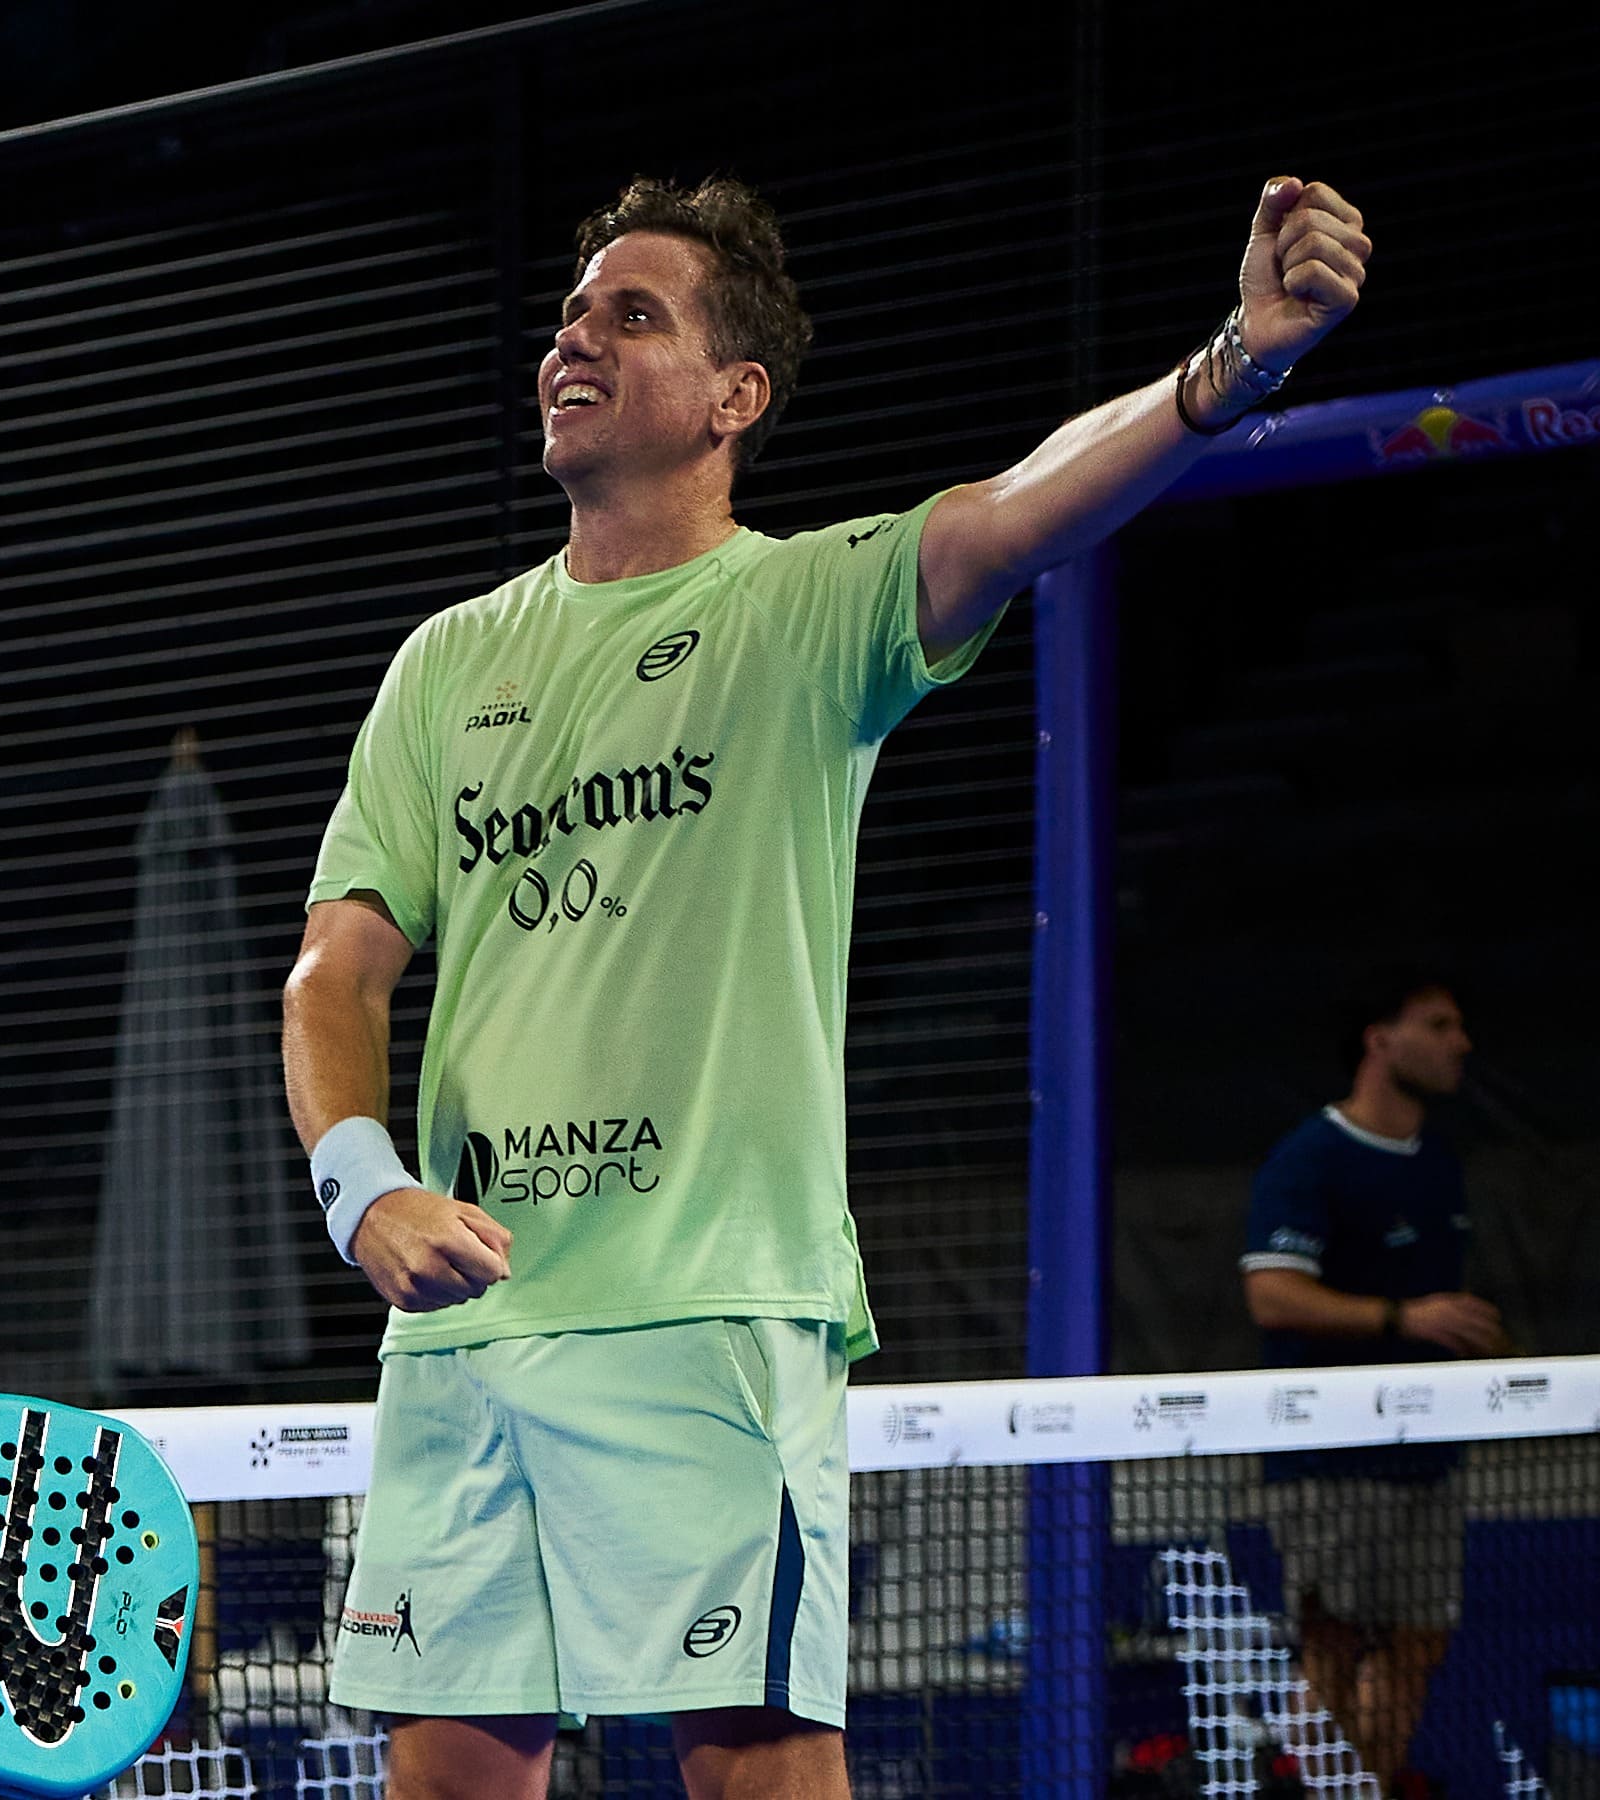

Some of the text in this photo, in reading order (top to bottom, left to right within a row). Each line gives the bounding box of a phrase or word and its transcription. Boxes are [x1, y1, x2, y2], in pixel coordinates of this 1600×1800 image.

[455, 745, 715, 874] Searam's
[504, 1116, 663, 1161] MANZA
[500, 1156, 660, 1206] sport
